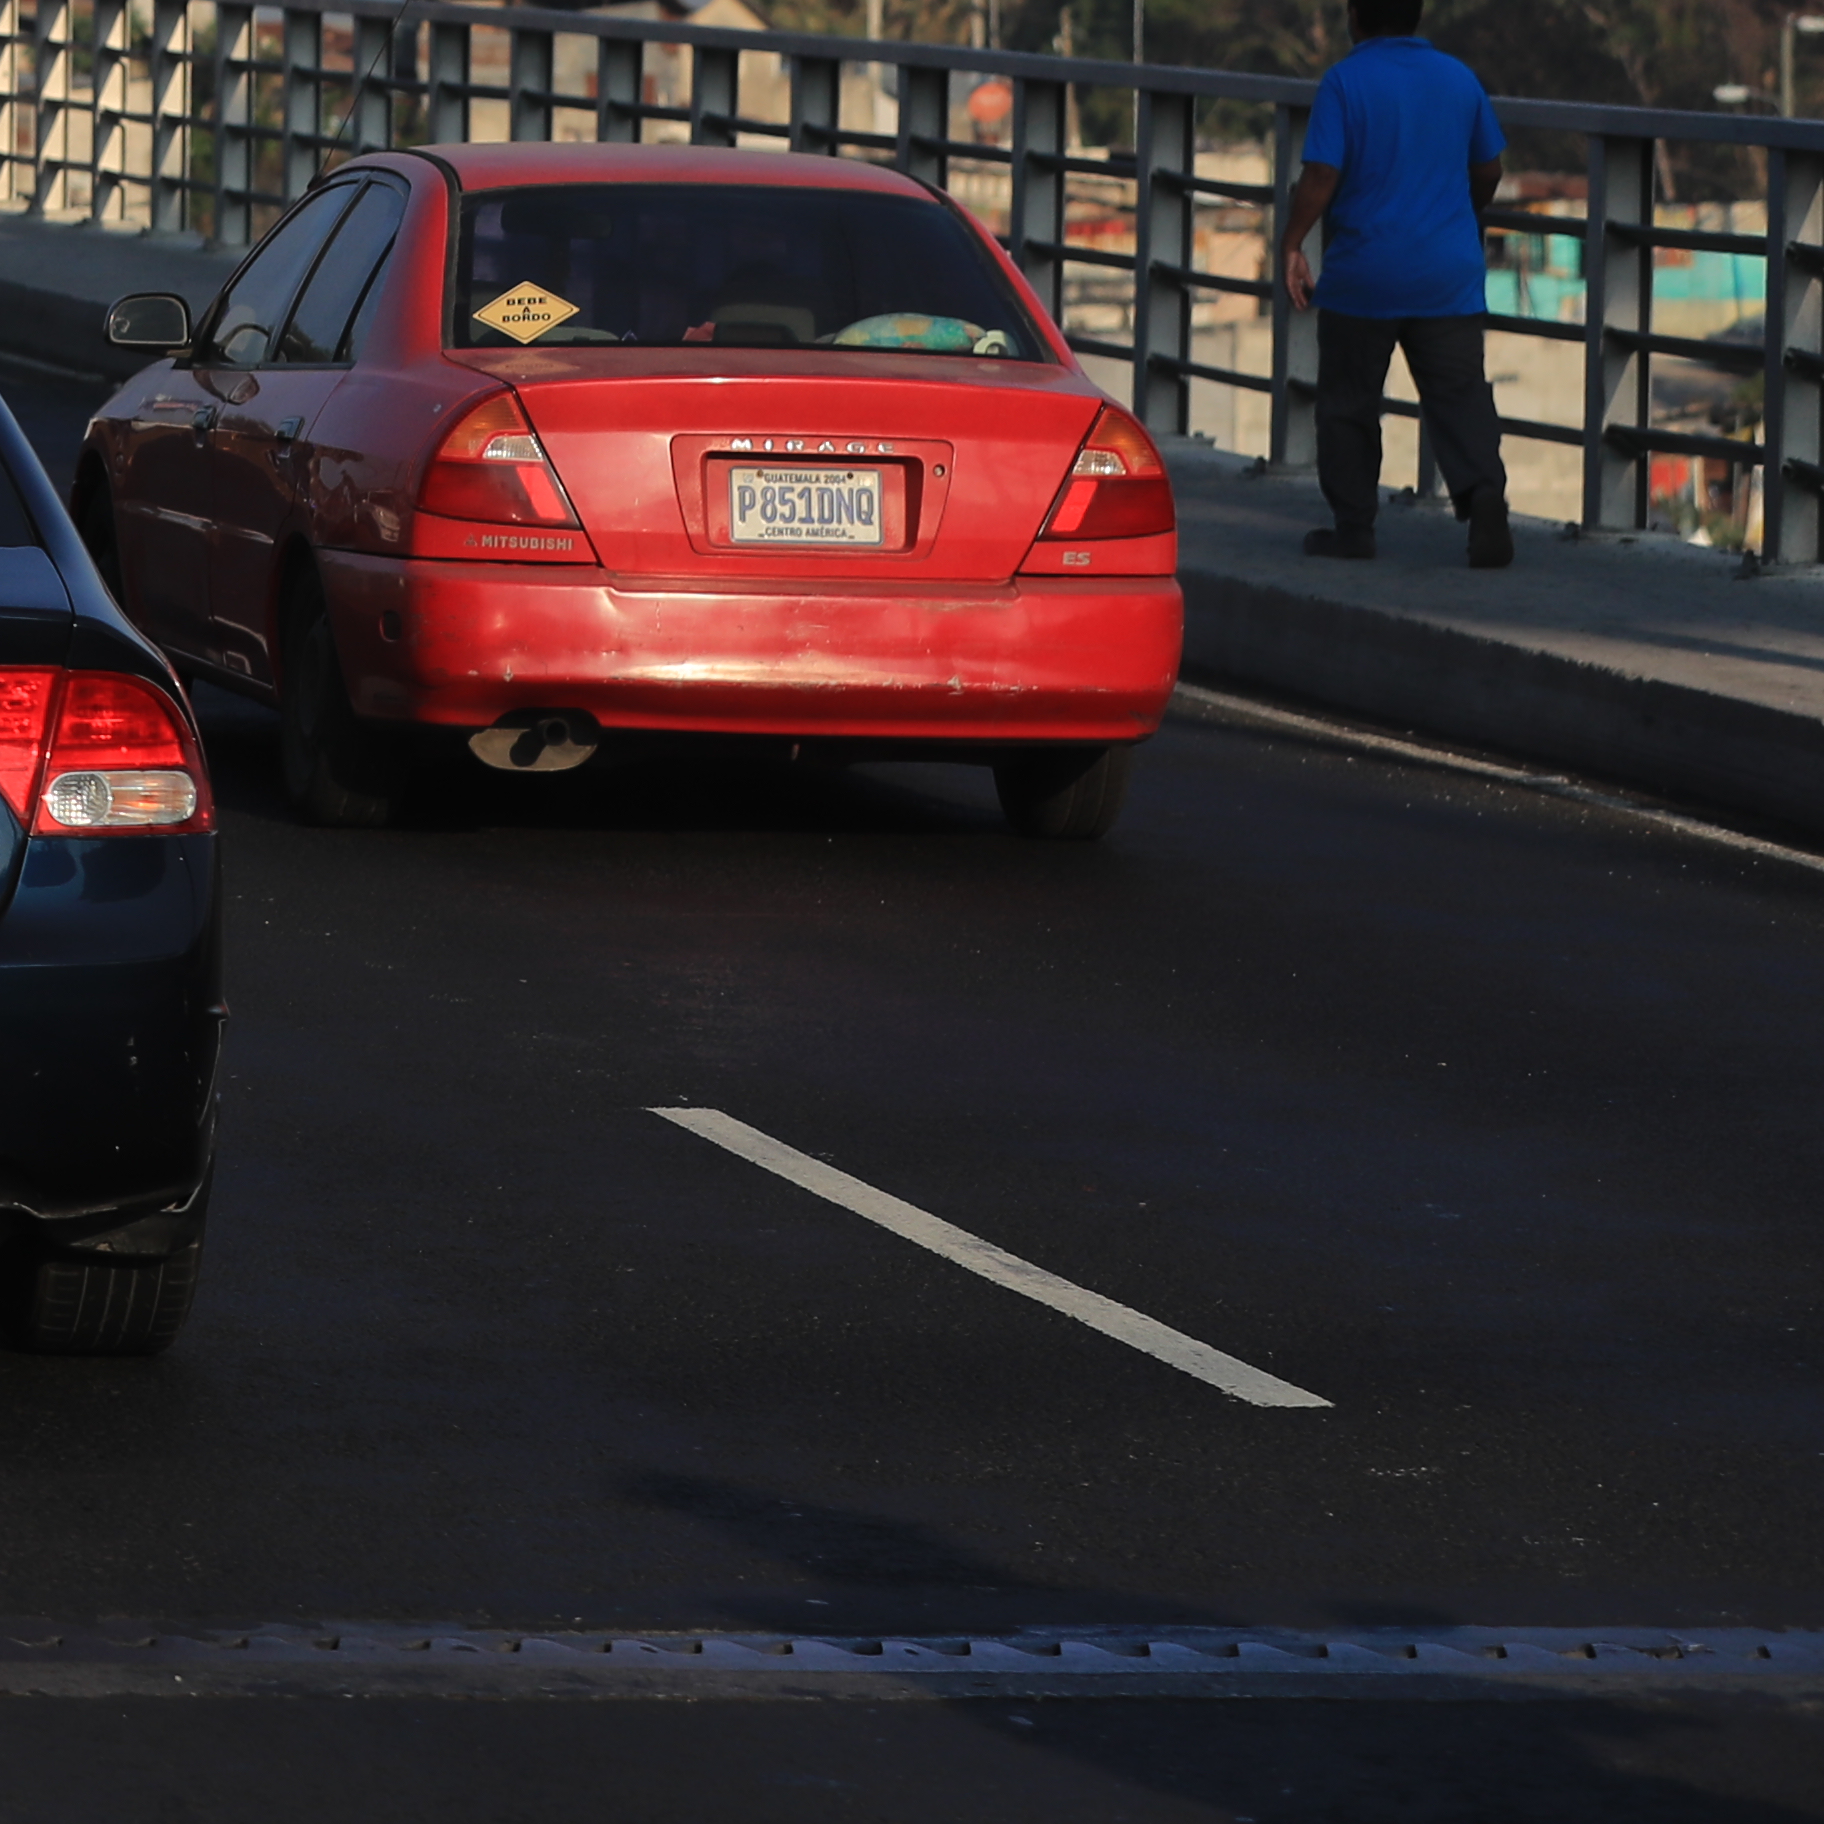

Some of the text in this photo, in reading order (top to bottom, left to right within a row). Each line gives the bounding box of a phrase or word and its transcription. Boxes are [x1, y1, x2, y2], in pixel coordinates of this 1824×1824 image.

[506, 297, 547, 306] BEBE
[523, 306, 531, 314] A
[502, 313, 551, 323] BORDO
[731, 438, 895, 454] MIRAGE
[764, 473, 846, 484] GUATEMALA 2004
[737, 485, 874, 526] P851DNQ
[765, 525, 847, 538] CENTRO AMÉRICA
[482, 535, 573, 551] MITSUBISHI
[1062, 551, 1091, 566] ES
